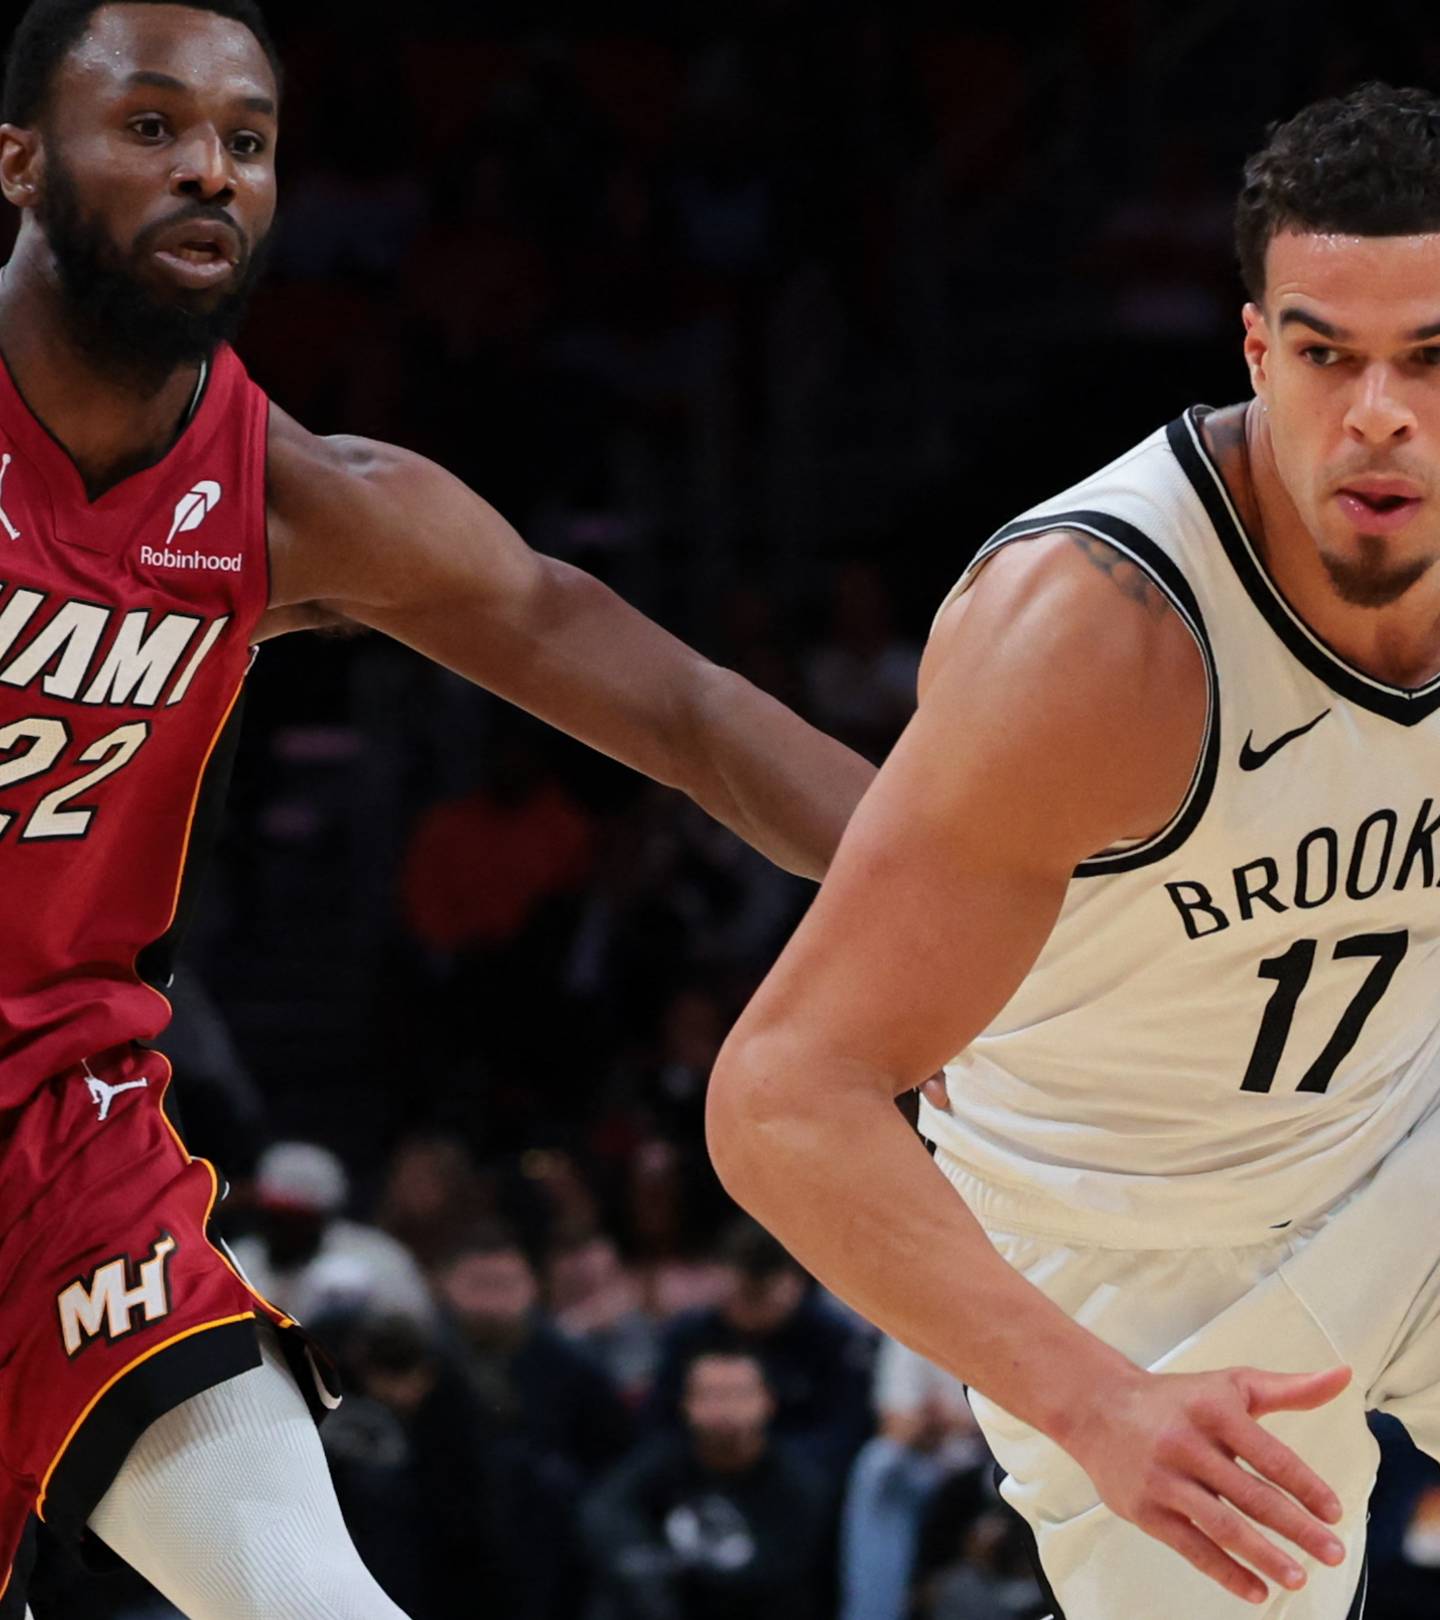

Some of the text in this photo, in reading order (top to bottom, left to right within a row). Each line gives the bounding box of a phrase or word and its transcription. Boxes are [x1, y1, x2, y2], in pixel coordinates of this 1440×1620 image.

[140, 545, 242, 572] Robinhood
[0, 581, 231, 707] IAMI
[1240, 929, 1409, 1094] 17
